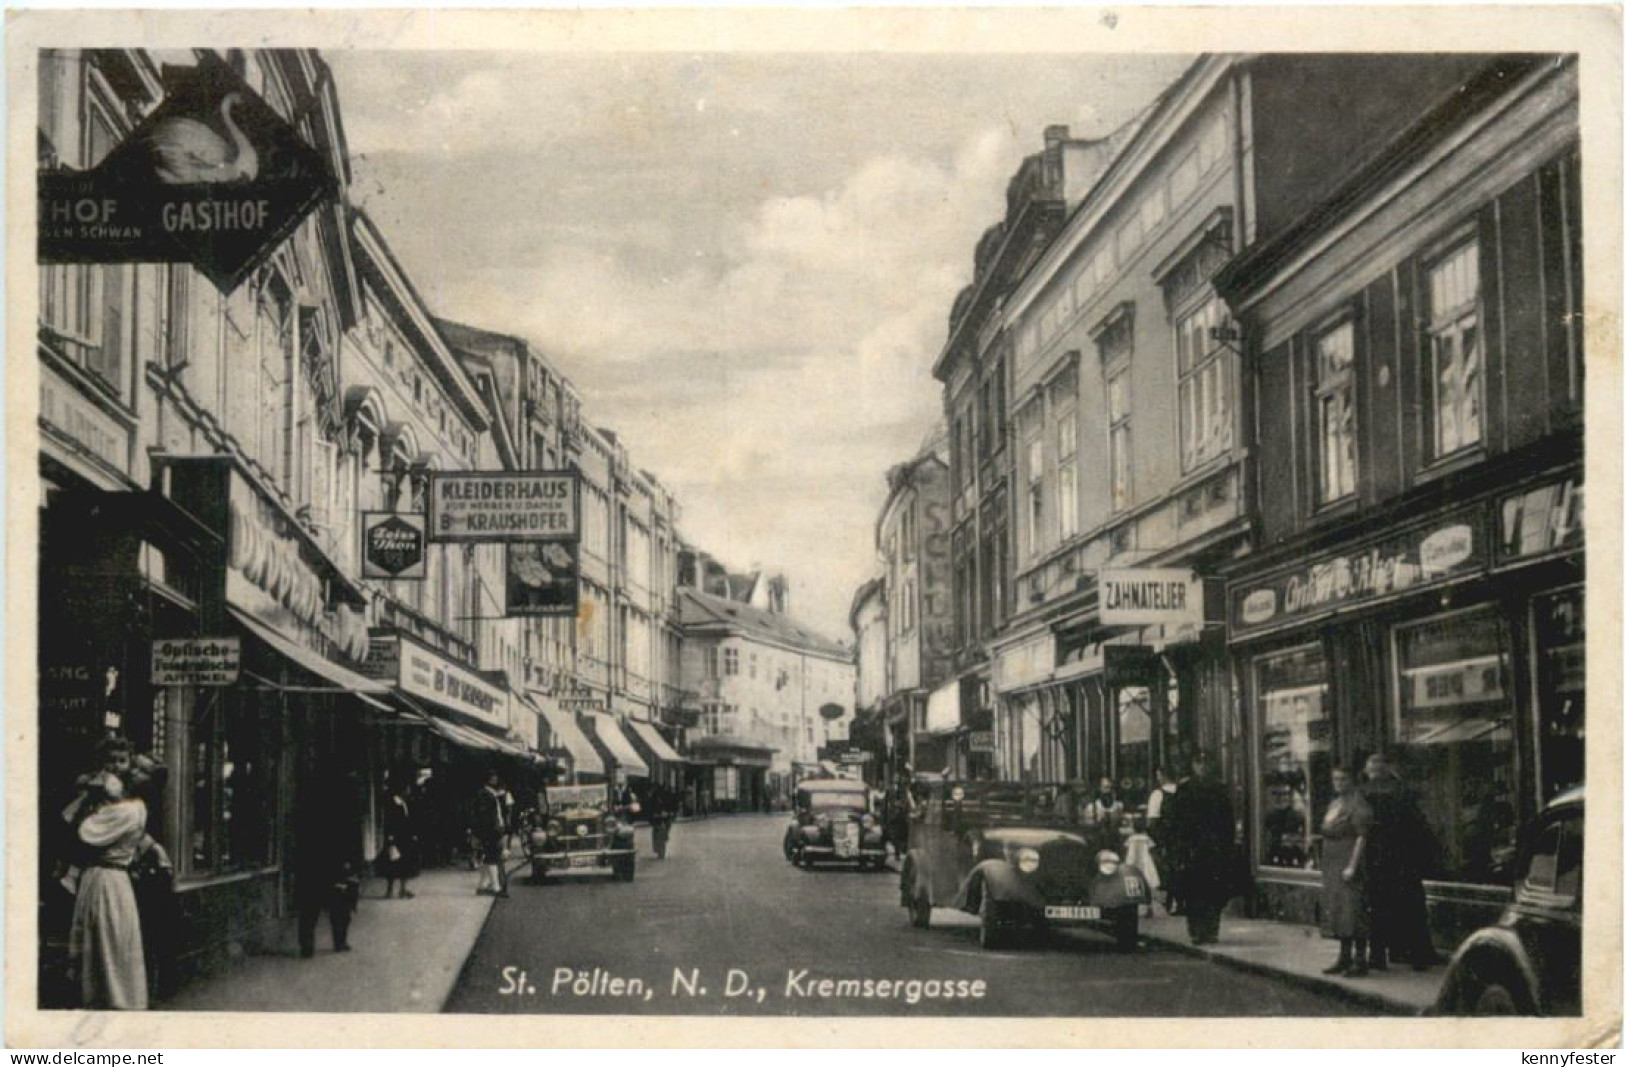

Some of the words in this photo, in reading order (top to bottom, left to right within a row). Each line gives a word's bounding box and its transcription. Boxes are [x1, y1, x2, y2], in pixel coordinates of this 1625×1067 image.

[162, 200, 269, 232] GASTHOF
[80, 225, 142, 238] SCHWAN
[442, 481, 568, 499] KLEIDERHAUS
[467, 512, 568, 530] KRAUSHOFER
[1106, 581, 1186, 610] ZAHNATELIER
